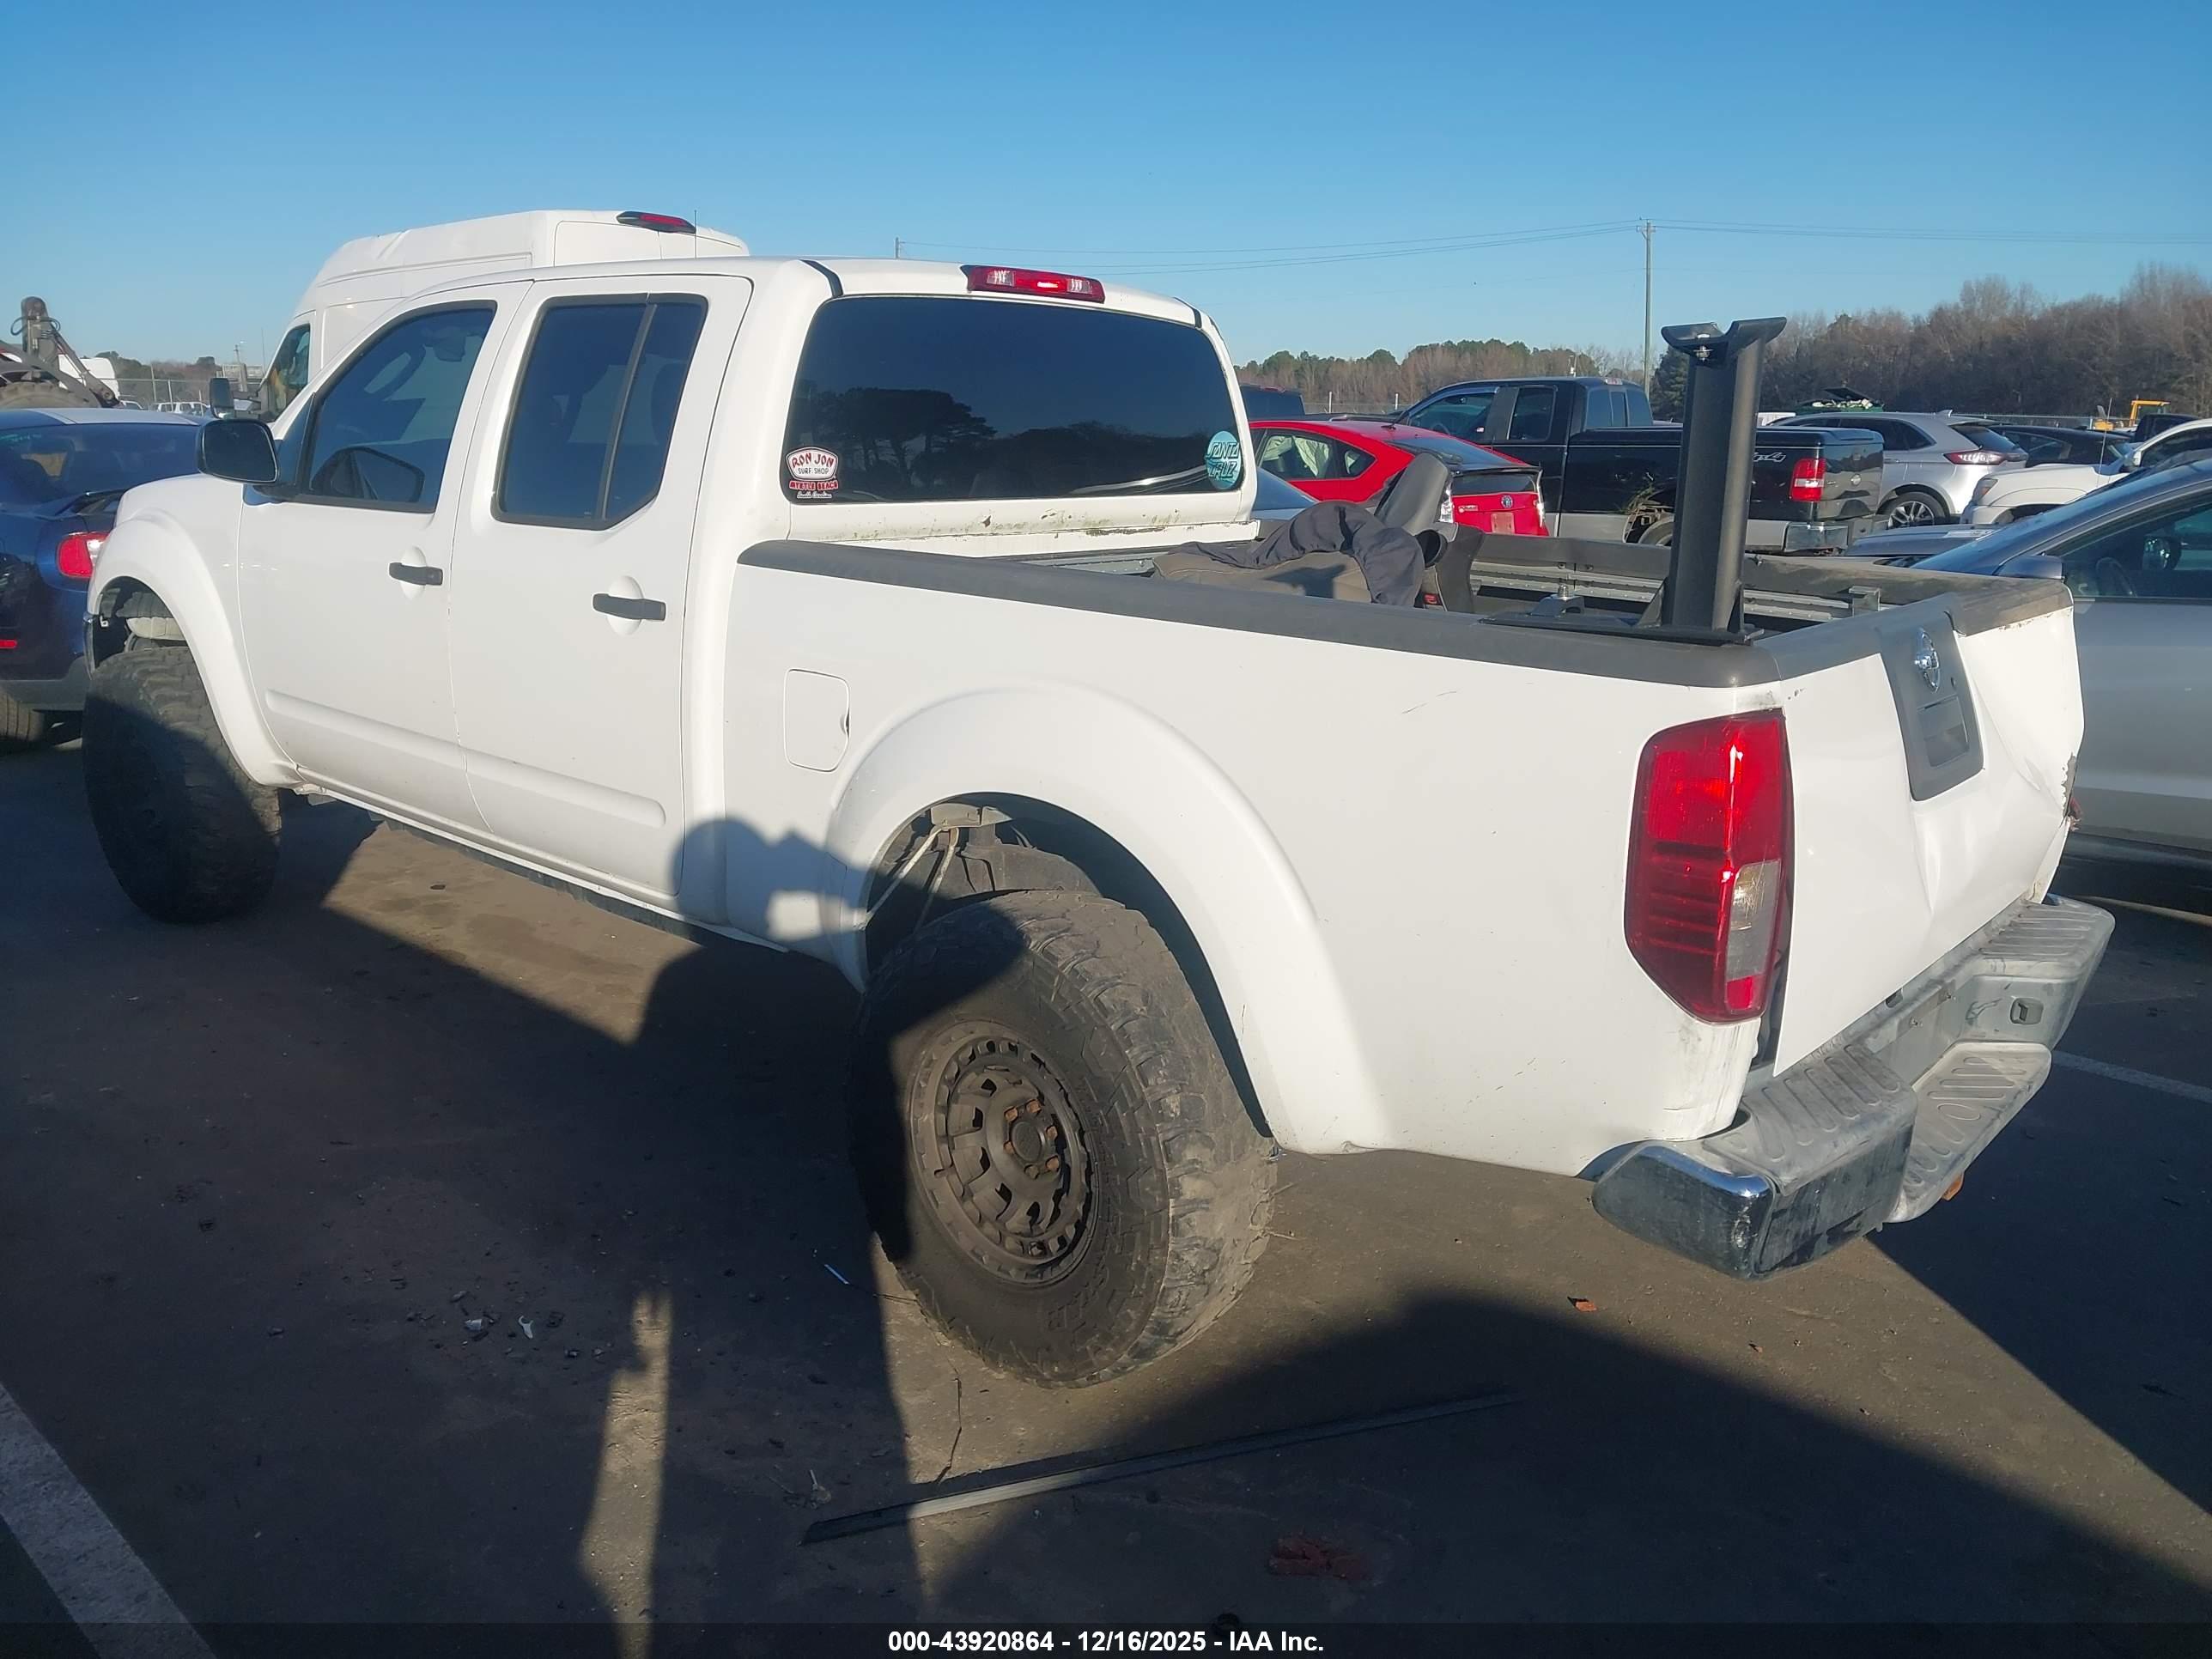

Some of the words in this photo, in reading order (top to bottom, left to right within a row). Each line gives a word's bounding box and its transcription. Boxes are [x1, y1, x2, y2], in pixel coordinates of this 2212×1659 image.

[1205, 441, 1239, 459] SANTA
[791, 453, 811, 469] RON
[814, 453, 834, 468] JON
[1208, 461, 1237, 478] CRUZ
[817, 480, 838, 490] BEACH
